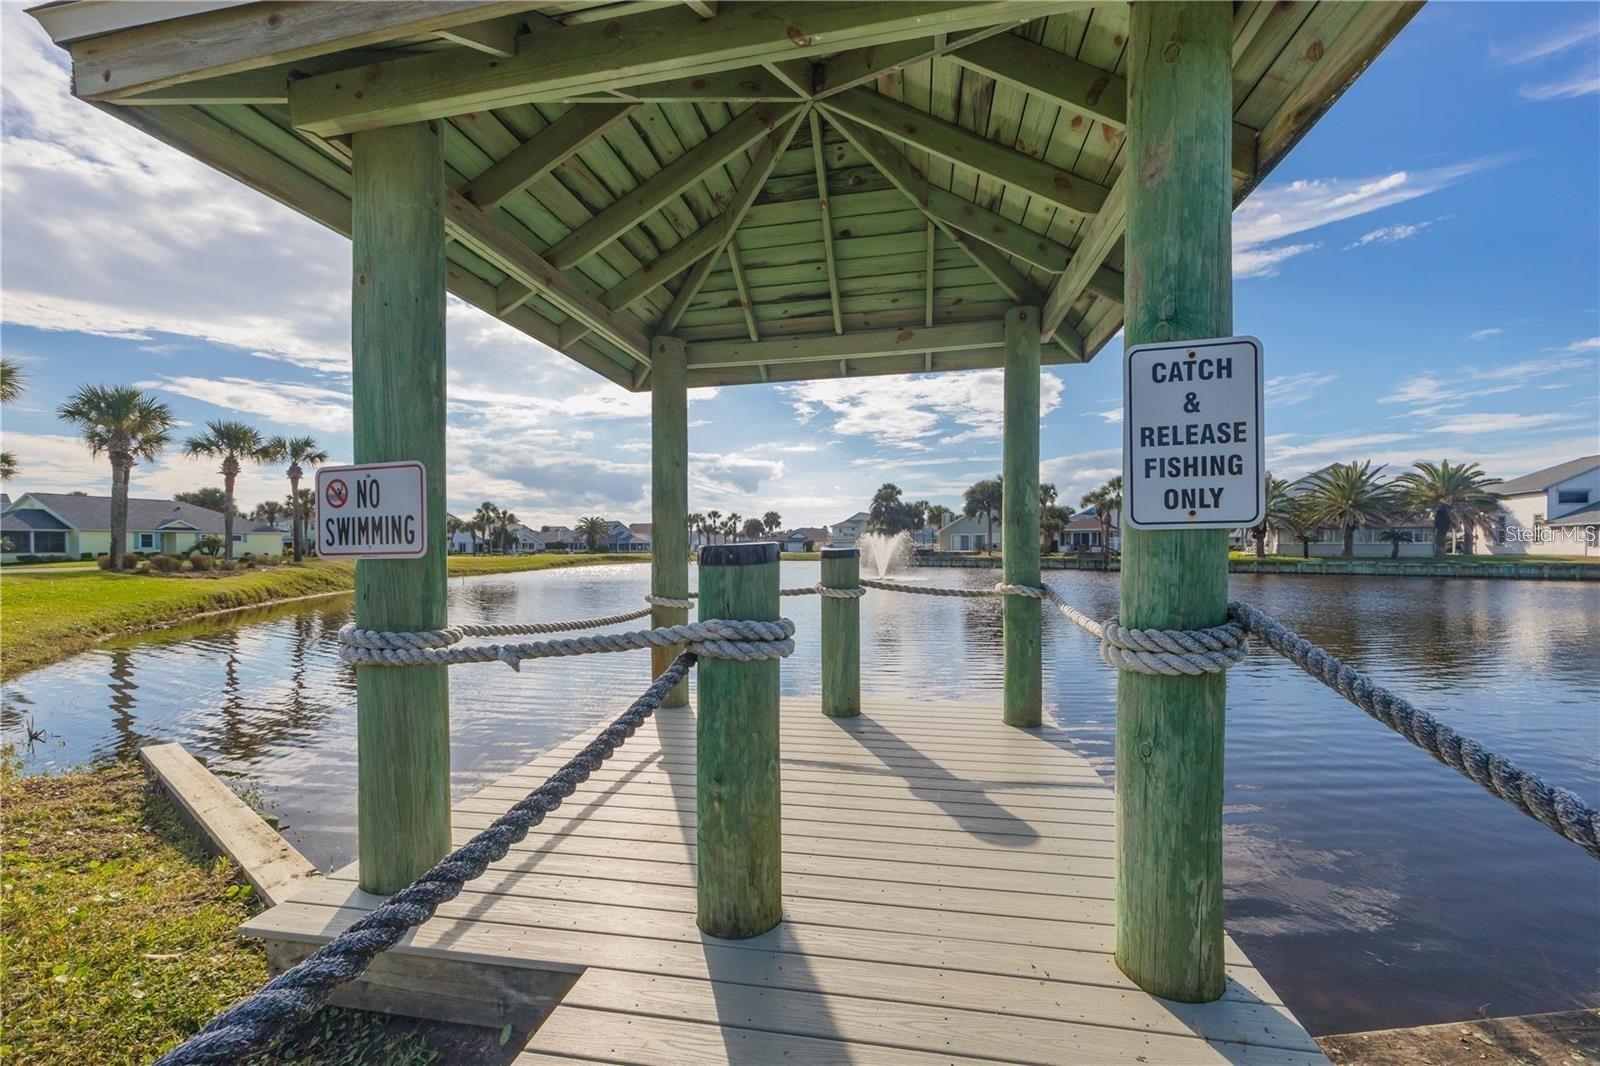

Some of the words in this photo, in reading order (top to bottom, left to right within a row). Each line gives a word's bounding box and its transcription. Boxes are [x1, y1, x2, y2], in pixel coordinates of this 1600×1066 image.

[1151, 357, 1233, 384] CATCH
[1183, 392, 1201, 413] &
[1140, 421, 1248, 447] RELEASE
[1144, 454, 1243, 479] FISHING
[356, 478, 380, 509] NO
[1163, 487, 1225, 510] ONLY
[325, 514, 415, 547] SWIMMING
